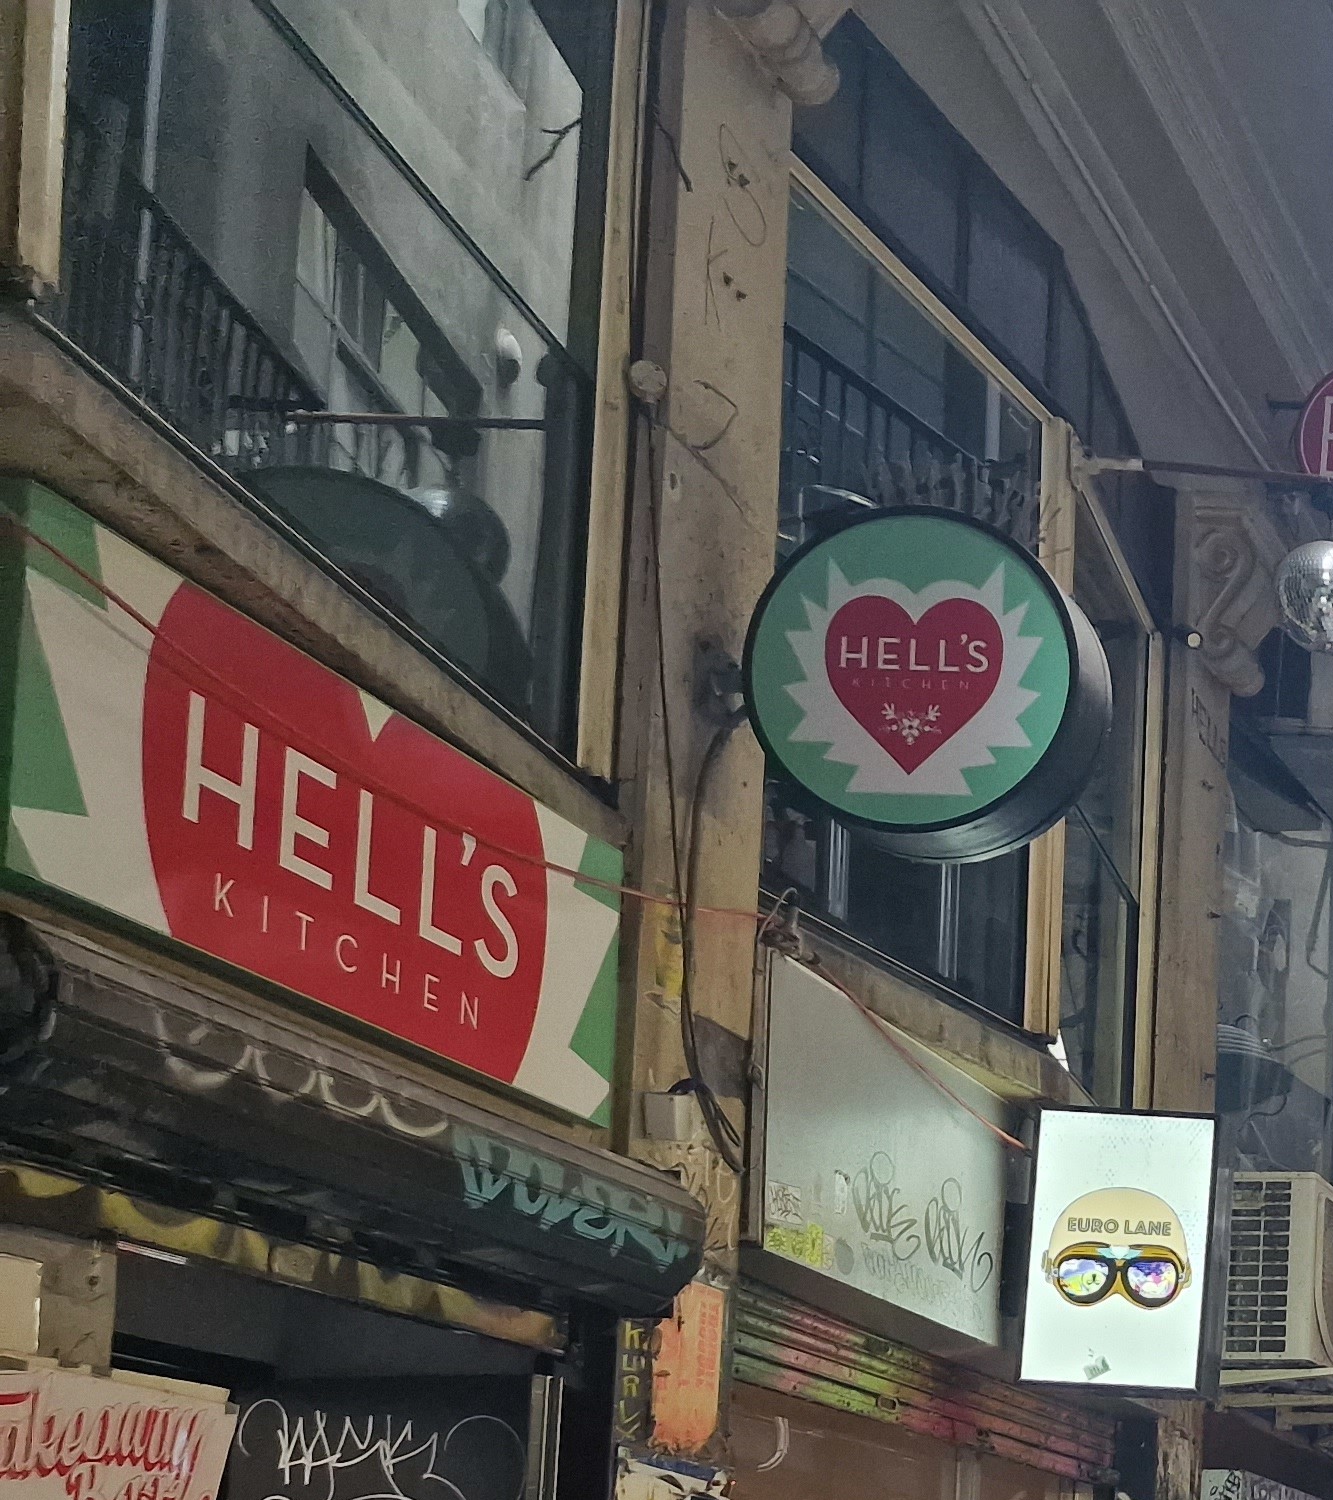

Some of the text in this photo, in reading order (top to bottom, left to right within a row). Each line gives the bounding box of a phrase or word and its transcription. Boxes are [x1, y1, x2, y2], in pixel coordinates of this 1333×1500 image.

[839, 632, 990, 674] HELL'S
[852, 675, 970, 692] KITCHEN
[182, 691, 519, 979] HELL'S
[213, 872, 480, 1030] KITCHEN
[1067, 1217, 1171, 1236] EURO LANE
